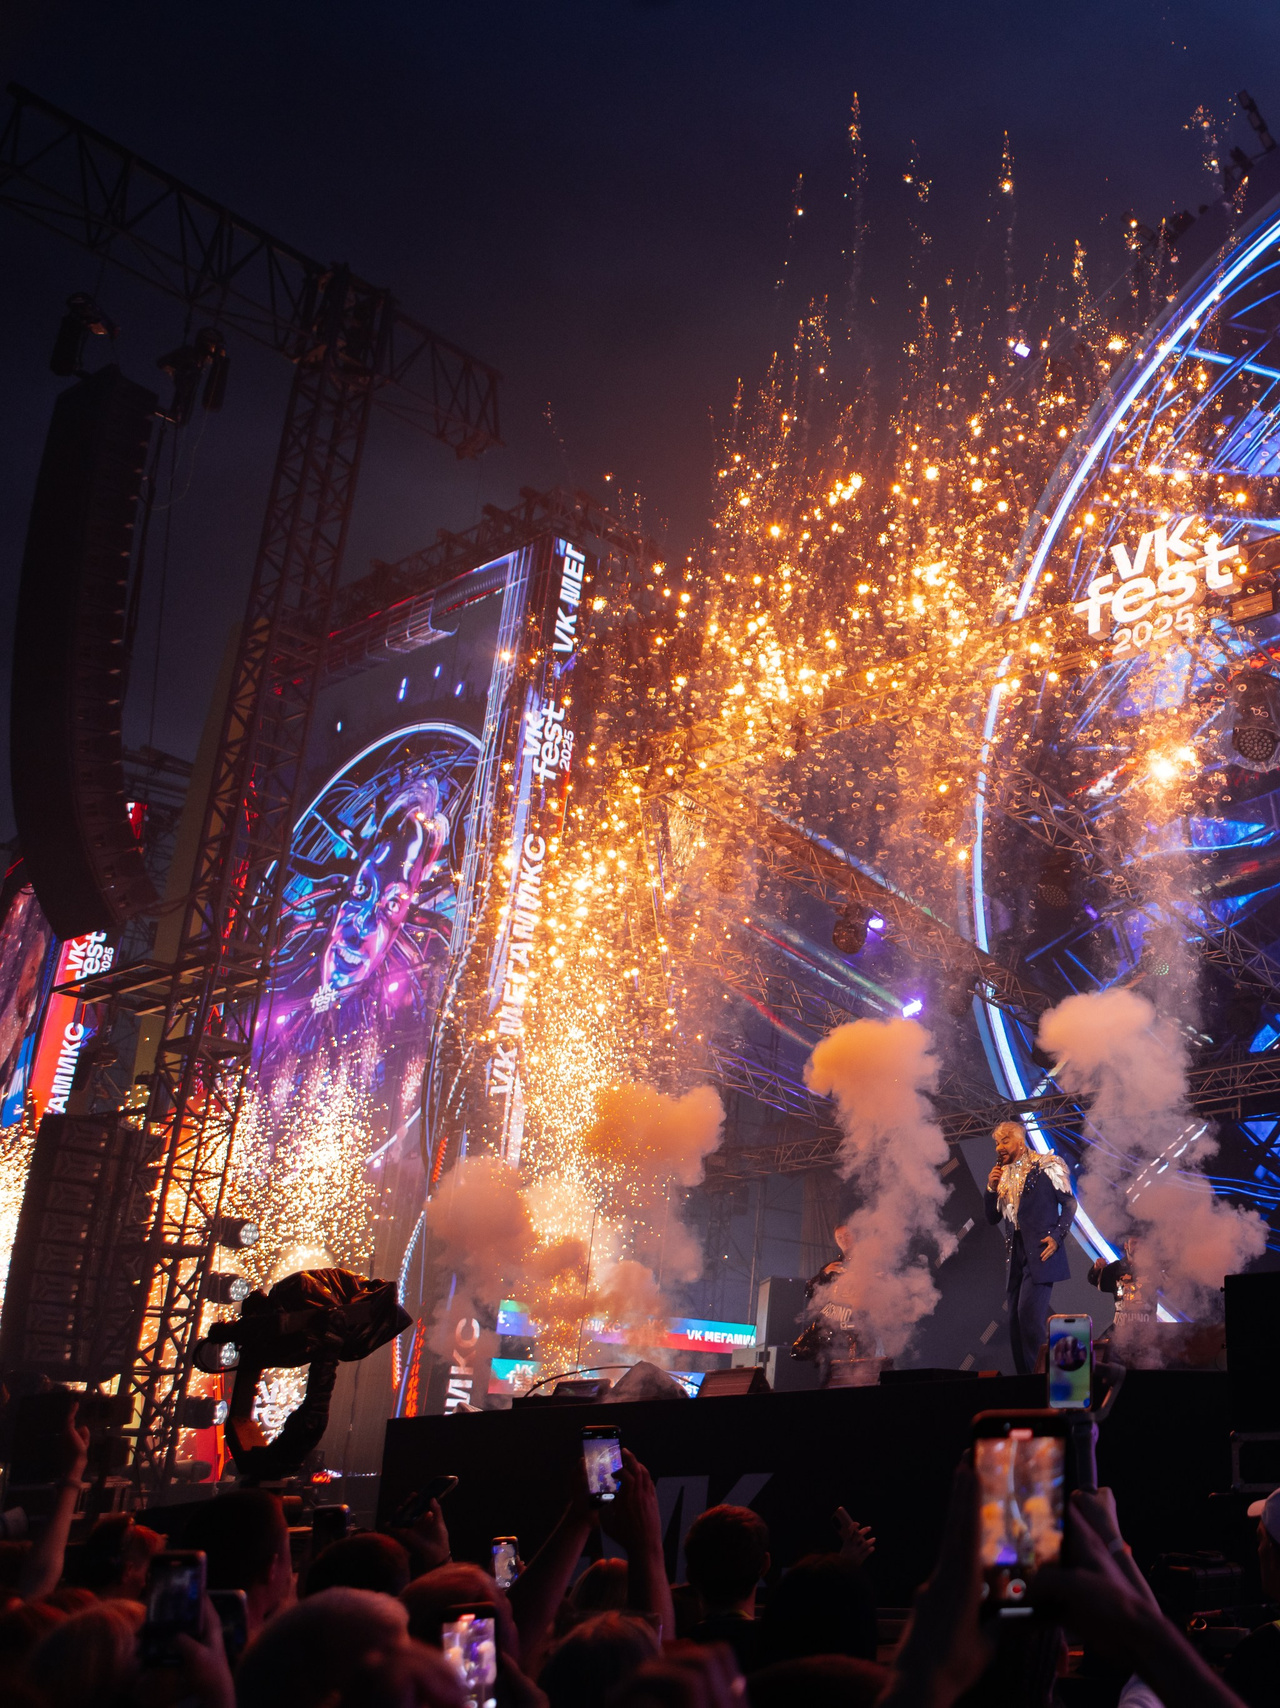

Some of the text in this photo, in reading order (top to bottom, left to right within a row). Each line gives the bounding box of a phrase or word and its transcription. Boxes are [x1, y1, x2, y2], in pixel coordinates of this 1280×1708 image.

[1110, 515, 1200, 580] VK
[1073, 533, 1240, 637] fest
[552, 606, 578, 653] VK
[1112, 603, 1196, 656] 2025
[522, 715, 546, 756] VK
[533, 700, 566, 784] fest
[559, 729, 575, 772] 2025
[65, 939, 89, 971] VK
[490, 1043, 518, 1095] VK
[686, 1328, 702, 1341] VK
[515, 1363, 535, 1375] VK
